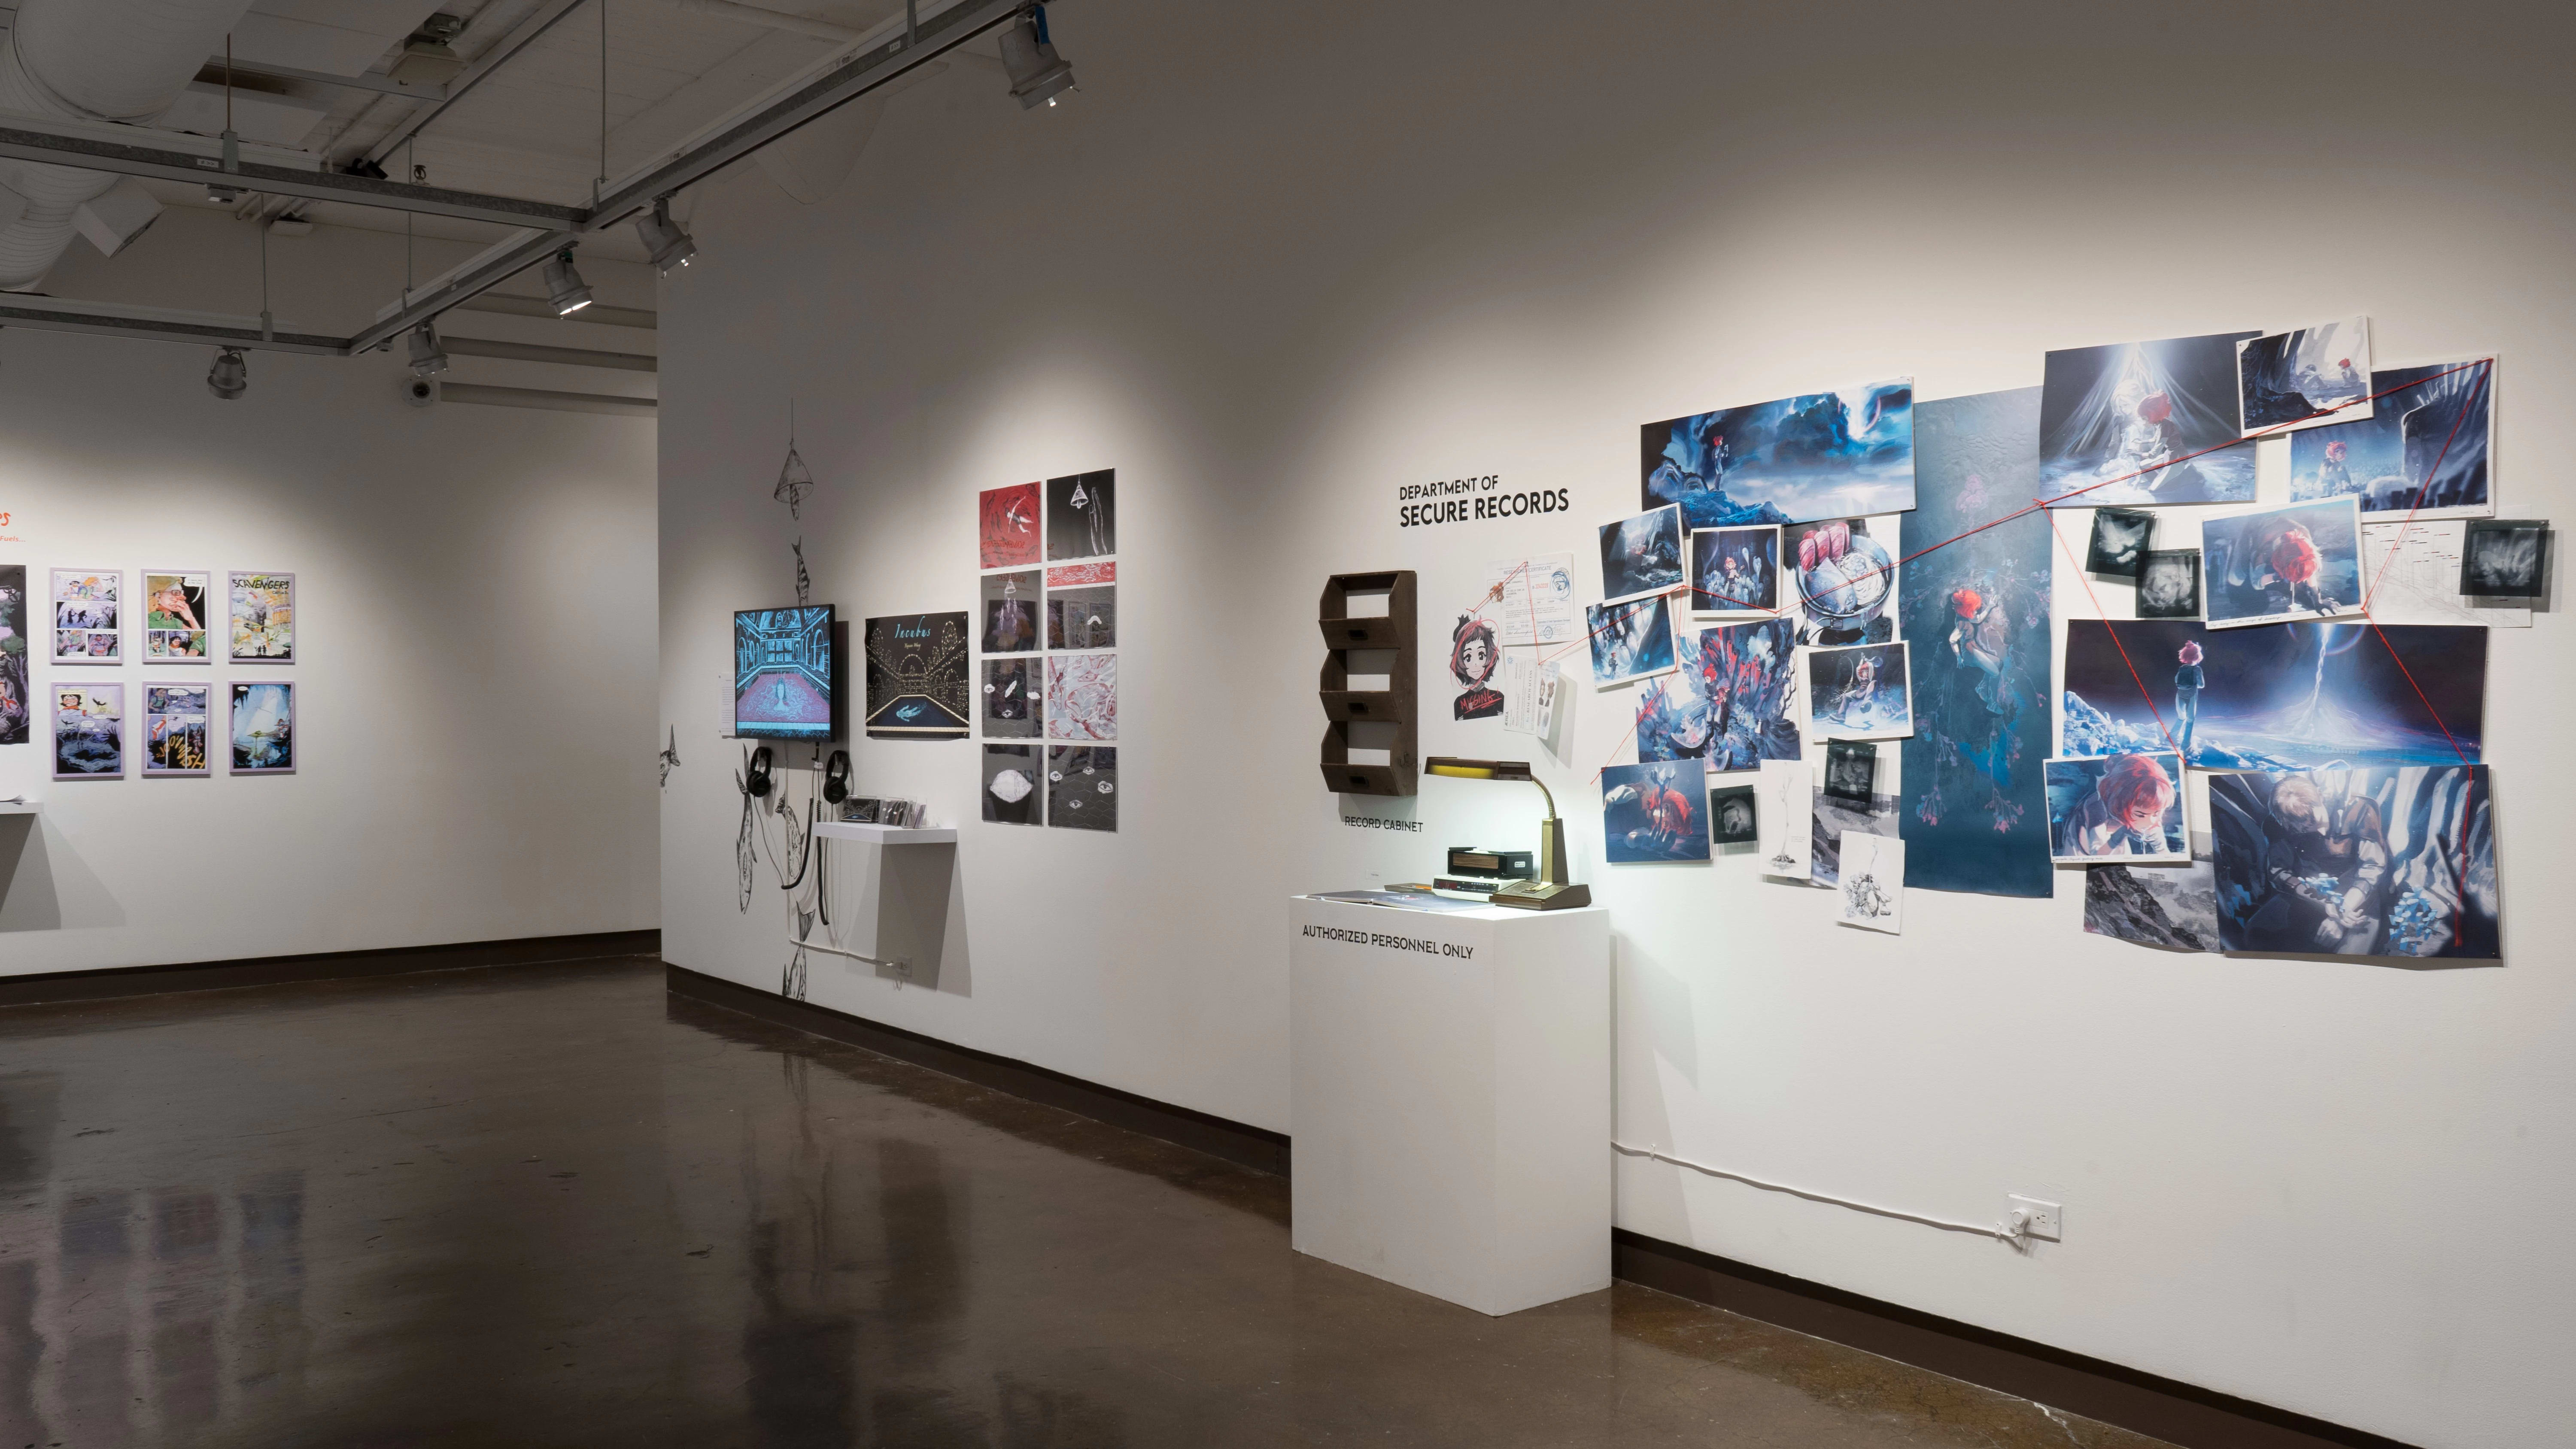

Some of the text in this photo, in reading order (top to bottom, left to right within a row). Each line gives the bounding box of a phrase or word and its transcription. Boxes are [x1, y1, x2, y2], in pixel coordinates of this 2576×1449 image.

[1400, 475, 1498, 500] DEPARTMENT OF
[1400, 488, 1569, 527] SECURE RECORDS
[232, 577, 290, 591] SCAVENGERS
[894, 615, 931, 638] Incubus
[1345, 816, 1423, 832] RECORD CABINET
[1303, 925, 1473, 959] AUTHORIZED PERSONNEL ONLY
